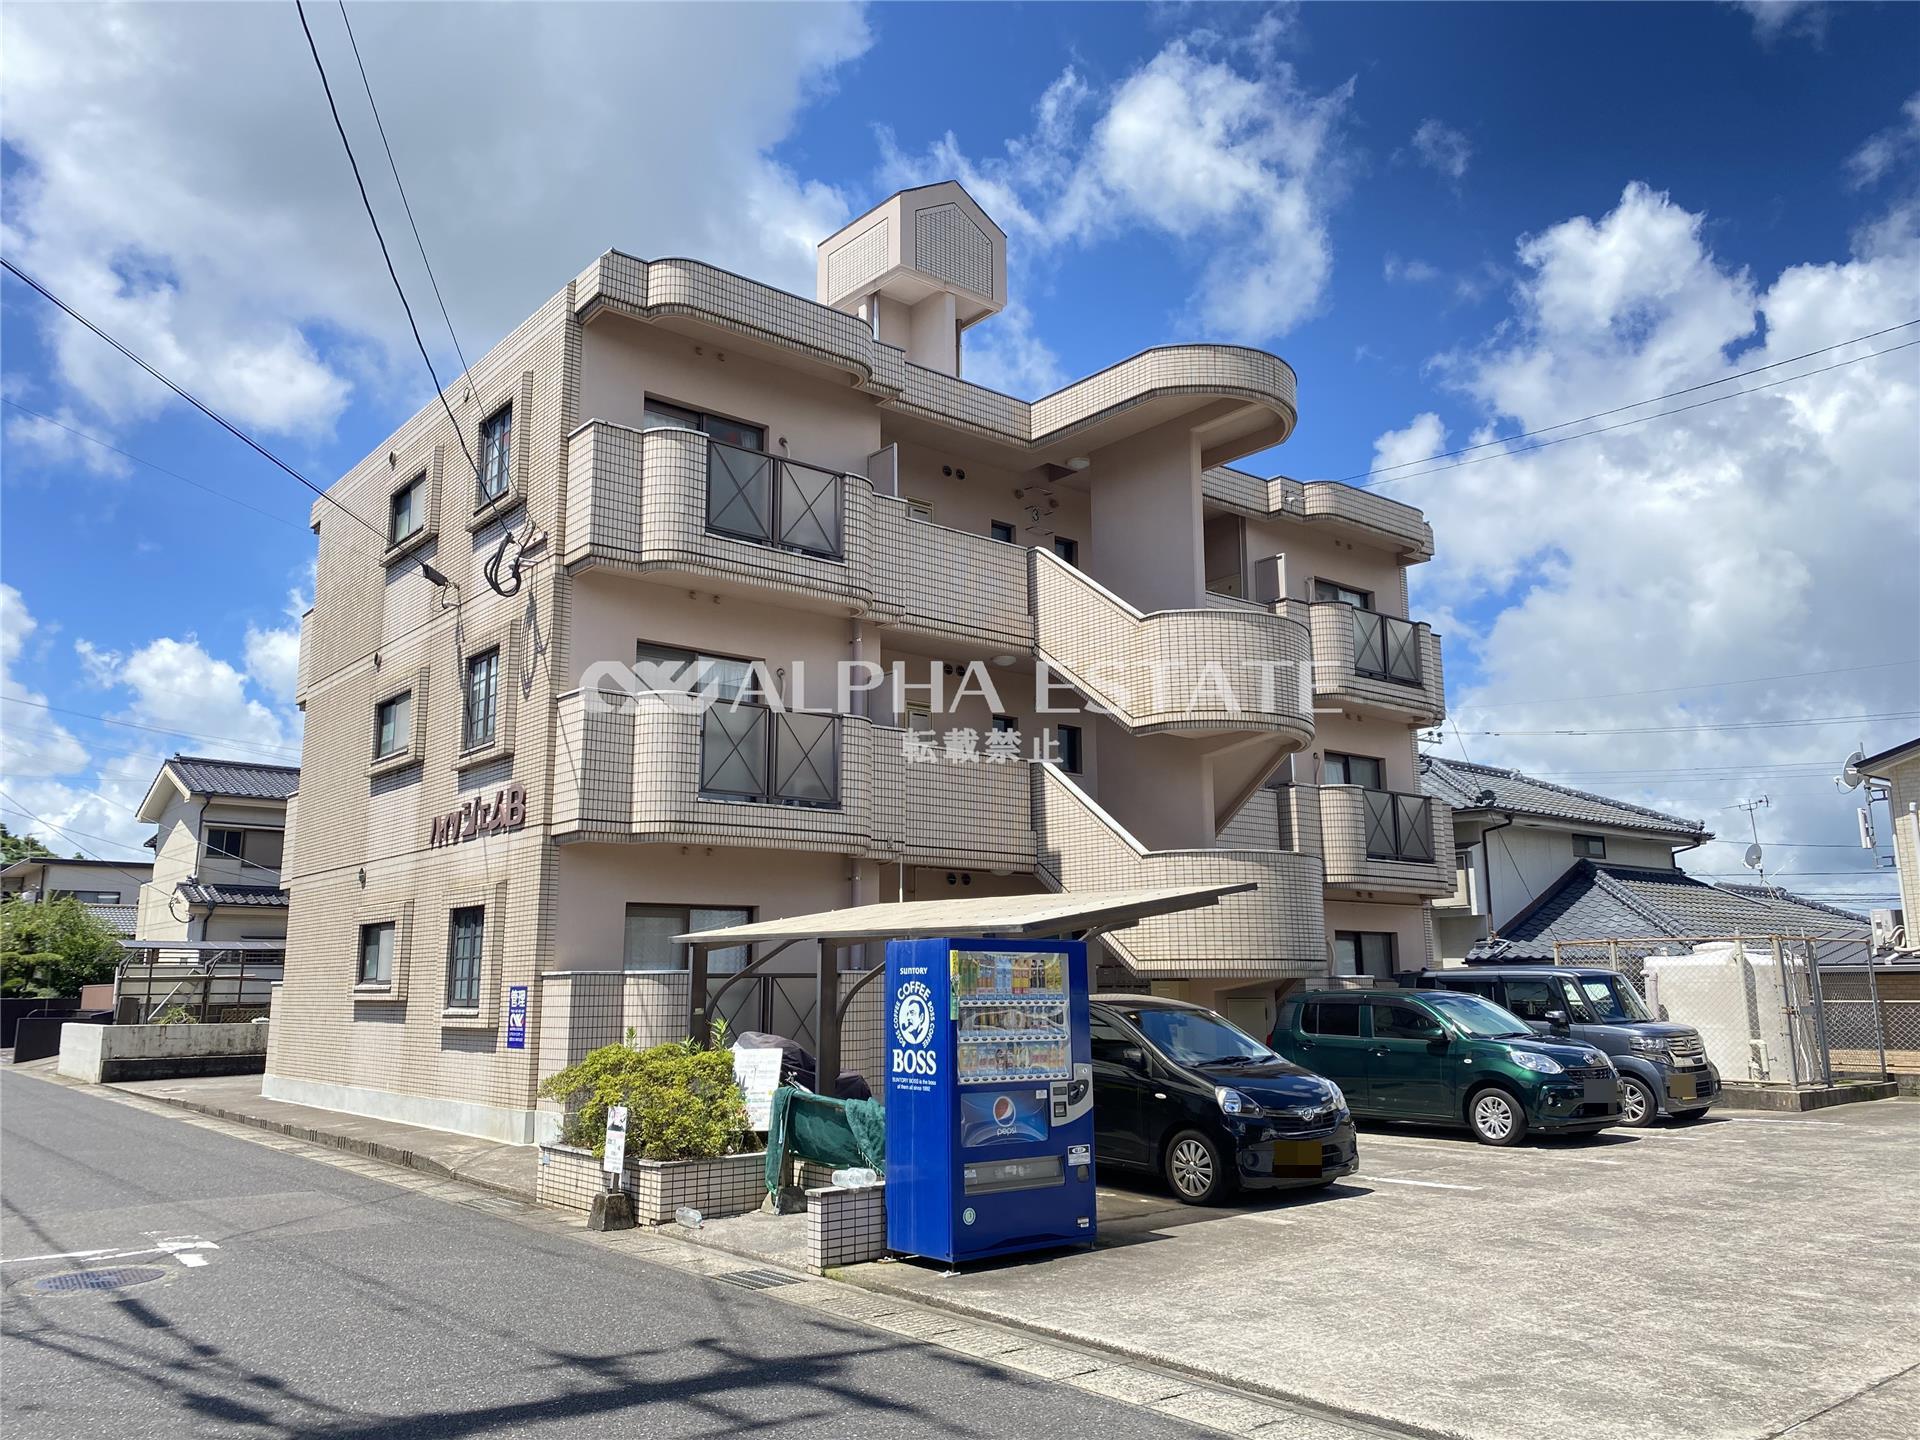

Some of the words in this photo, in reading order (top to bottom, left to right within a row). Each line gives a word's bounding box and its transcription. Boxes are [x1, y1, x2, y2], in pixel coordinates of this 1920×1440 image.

[1032, 508, 1039, 521] 3
[900, 967, 928, 975] SUNTORY
[897, 981, 931, 1001] COFFEE
[511, 990, 526, 1008] 管理
[892, 1049, 937, 1076] BOSS
[997, 1126, 1017, 1136] pepsi
